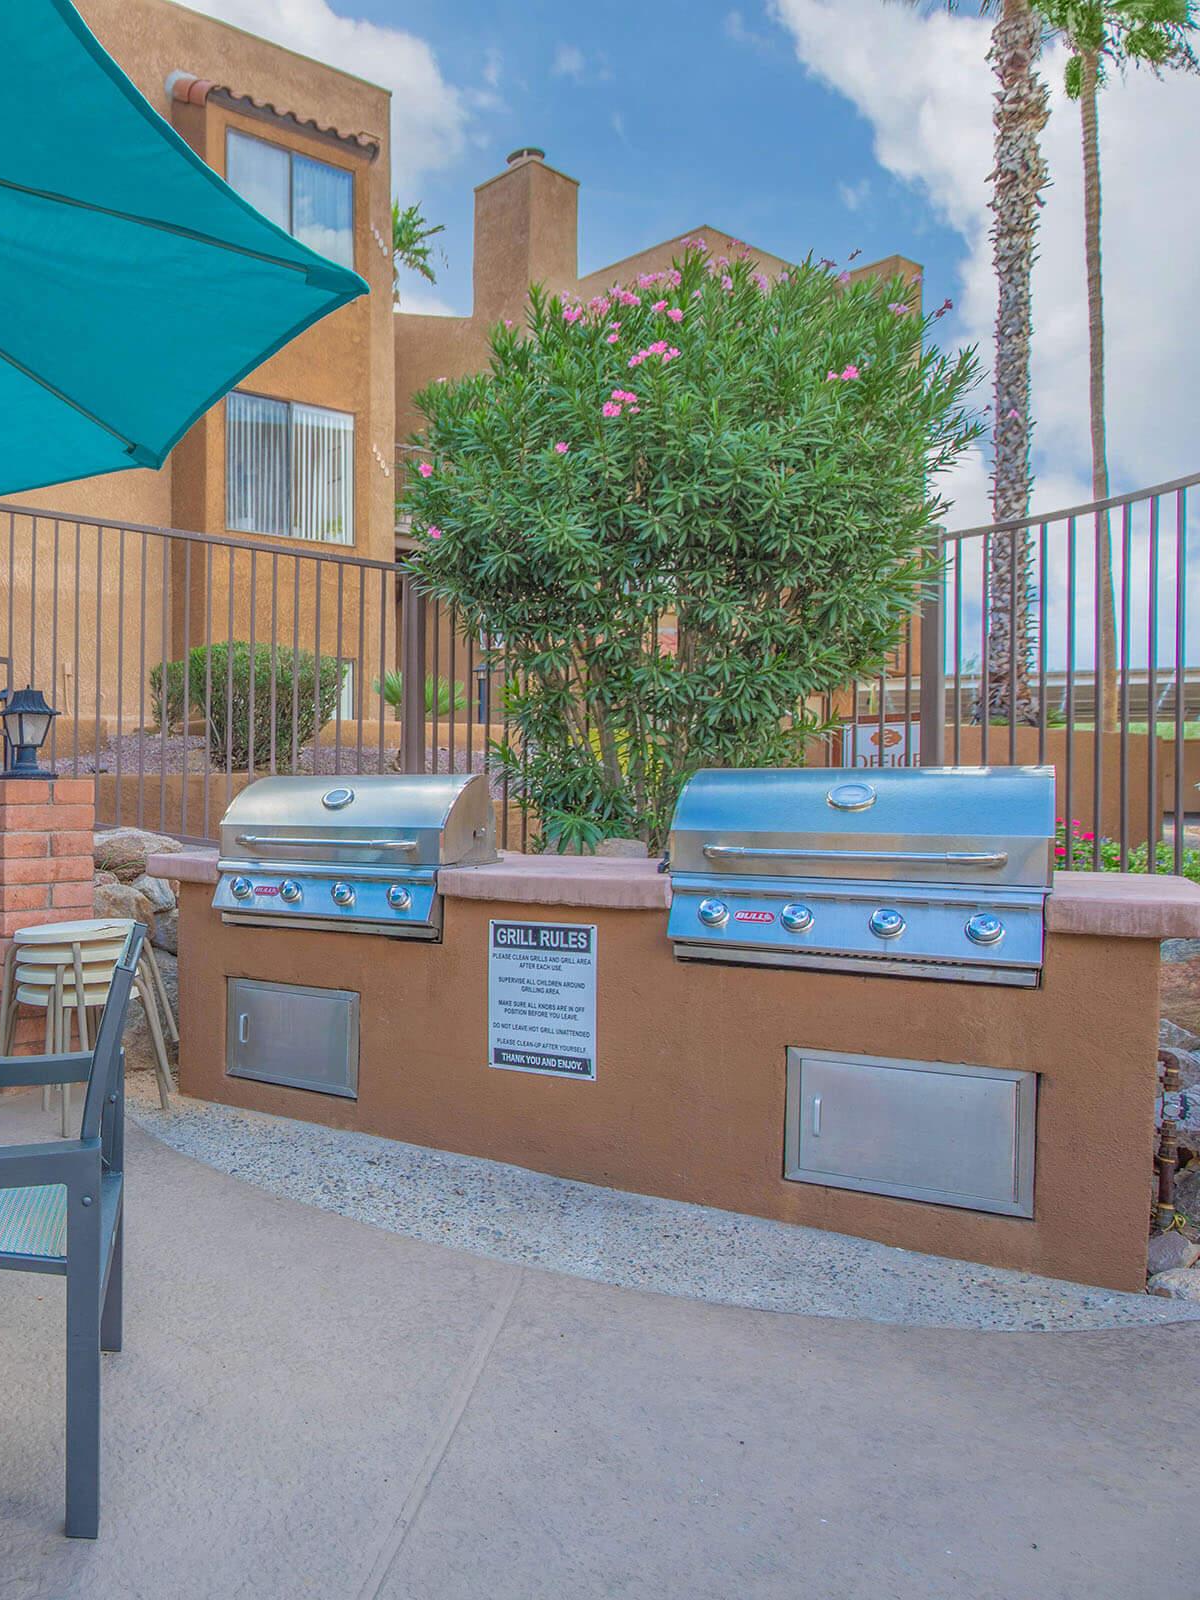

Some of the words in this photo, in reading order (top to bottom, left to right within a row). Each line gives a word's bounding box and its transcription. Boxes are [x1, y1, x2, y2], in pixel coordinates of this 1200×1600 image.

[497, 928, 537, 946] GRILL
[540, 930, 588, 949] RULES
[499, 976, 526, 985] SUPERVISE
[537, 979, 561, 987] CHILDREN
[563, 981, 585, 989] AROUND
[521, 986, 545, 994] GRILLING
[538, 1003, 555, 1011] KNOBS
[504, 1008, 527, 1016] POSITION
[528, 1009, 548, 1017] BEFORE
[549, 1011, 560, 1019] YOU
[540, 1026, 555, 1034] GRILL
[556, 1028, 590, 1038] UNATTENDED
[497, 1038, 516, 1046] PLEASE
[516, 1039, 541, 1048] CLEAN-UP
[542, 1042, 558, 1050] AFTER
[502, 1052, 525, 1063] THANK
[525, 1054, 540, 1065] YOU
[541, 1056, 557, 1067] AND
[558, 1059, 582, 1071] ENJOY.
